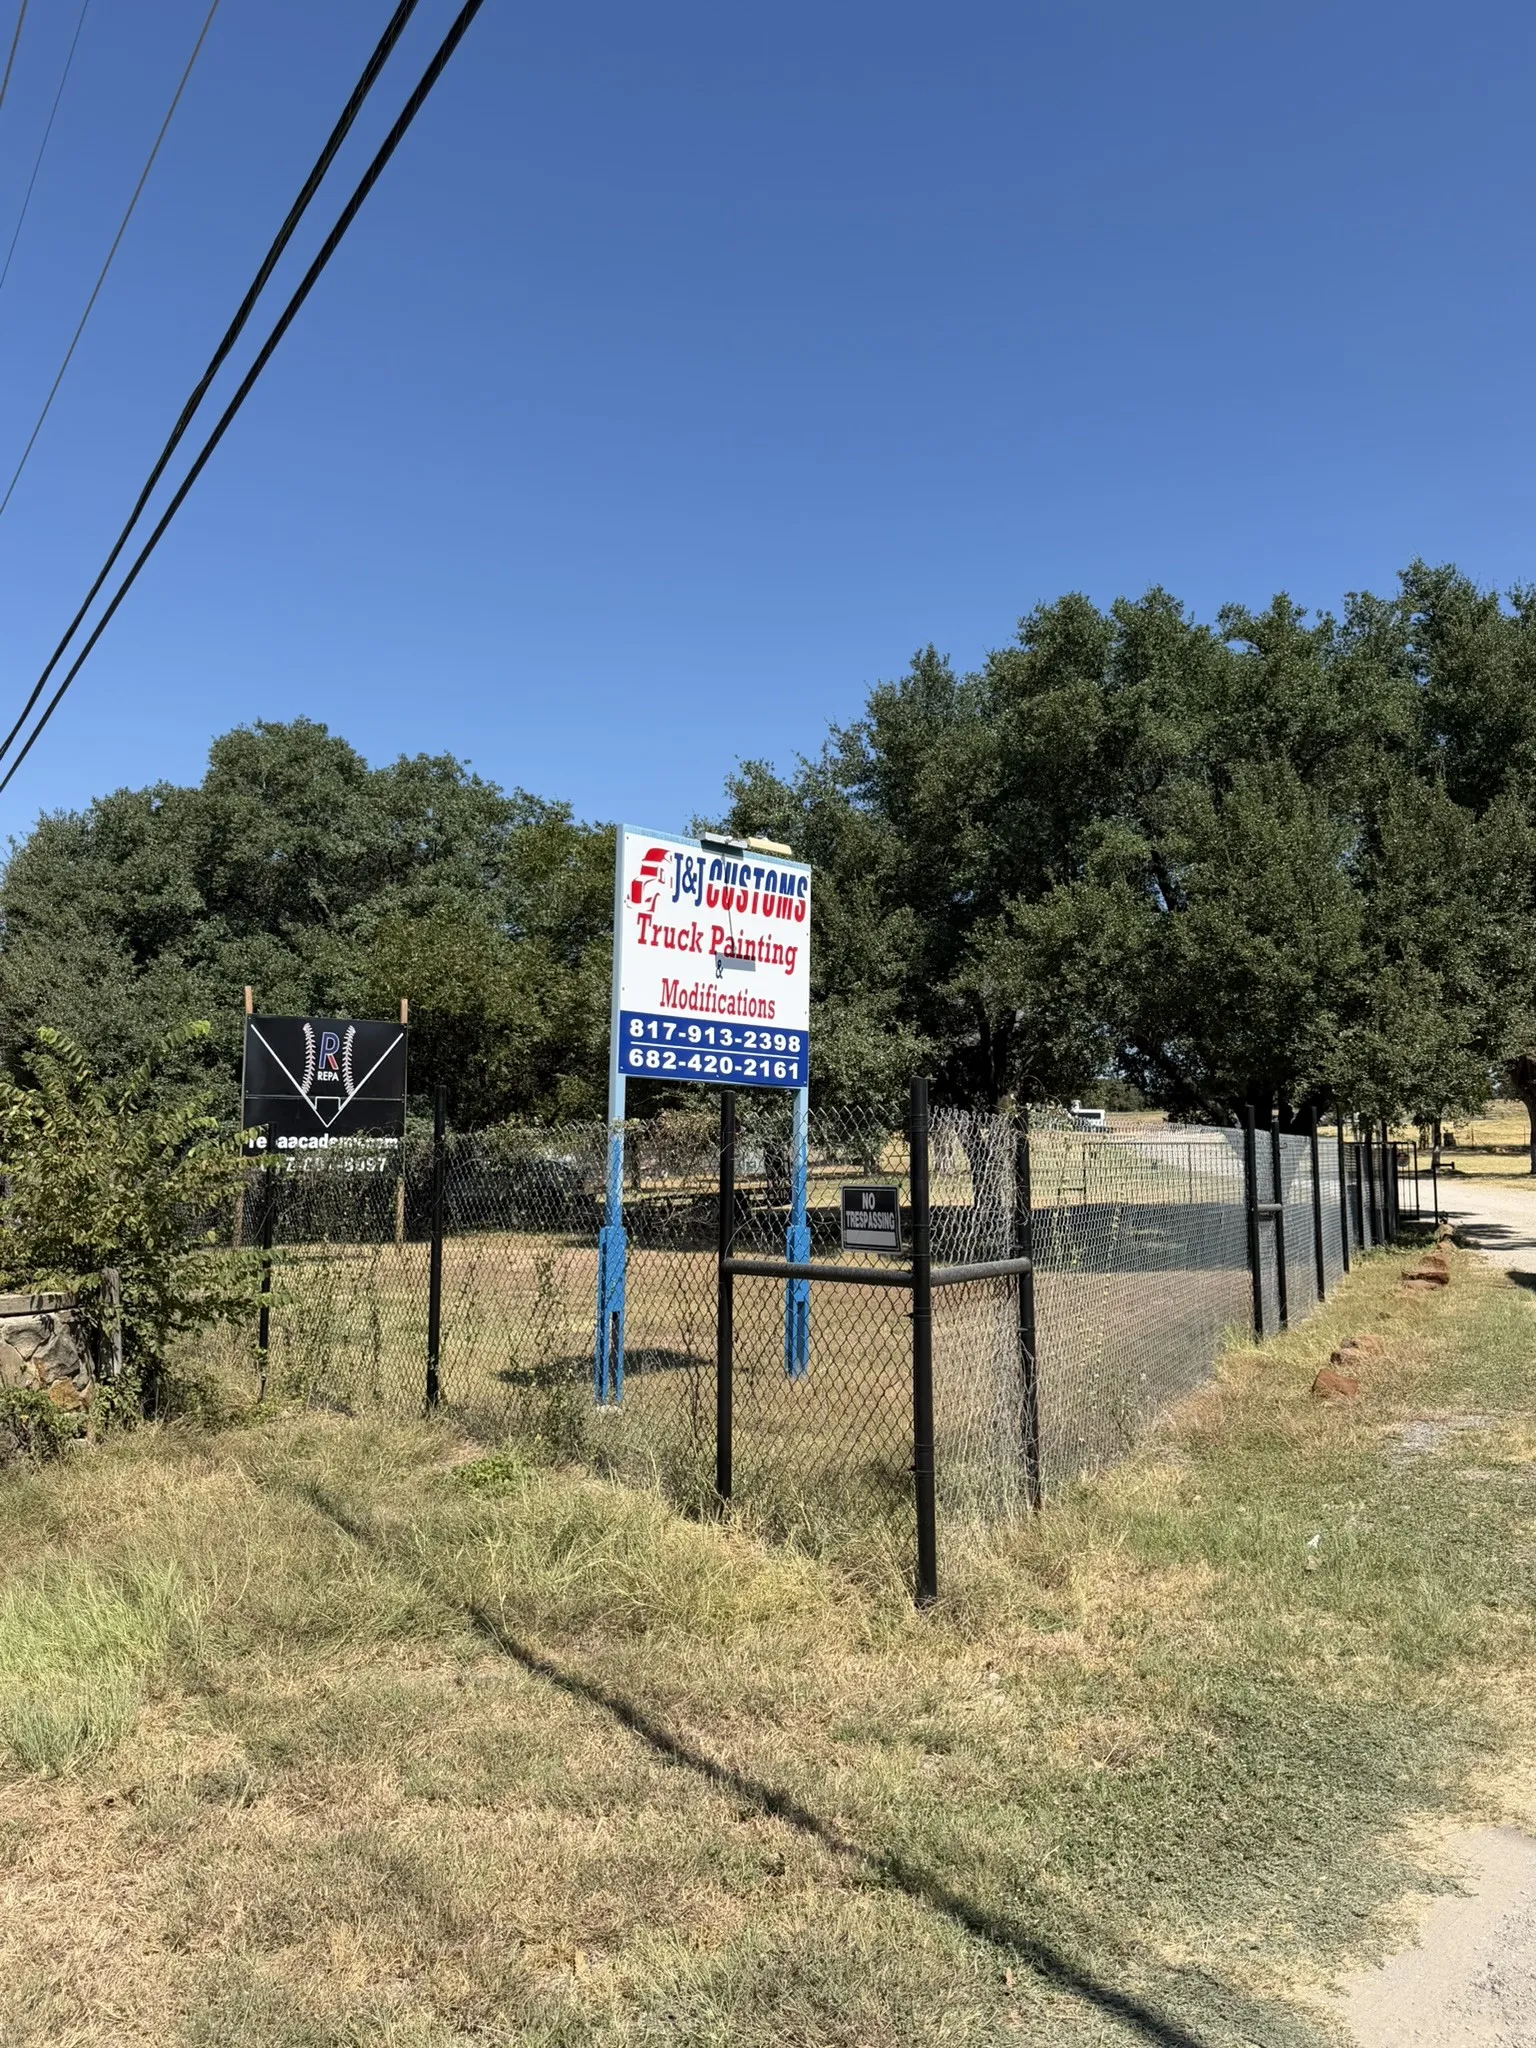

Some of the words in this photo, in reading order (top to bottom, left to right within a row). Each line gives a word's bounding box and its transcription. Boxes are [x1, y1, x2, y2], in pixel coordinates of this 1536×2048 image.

[672, 852, 706, 907] J&J
[706, 858, 808, 923] CUSTOMS
[637, 912, 703, 954] Truck
[709, 924, 798, 975] Painting
[715, 959, 724, 979] &
[660, 978, 775, 1020] Modifications
[629, 1018, 801, 1052] 817-913-2398
[317, 1071, 339, 1081] REPA
[628, 1048, 799, 1080] 682-420-2161
[862, 1192, 876, 1210] NO
[845, 1210, 895, 1230] TRESPASSING
